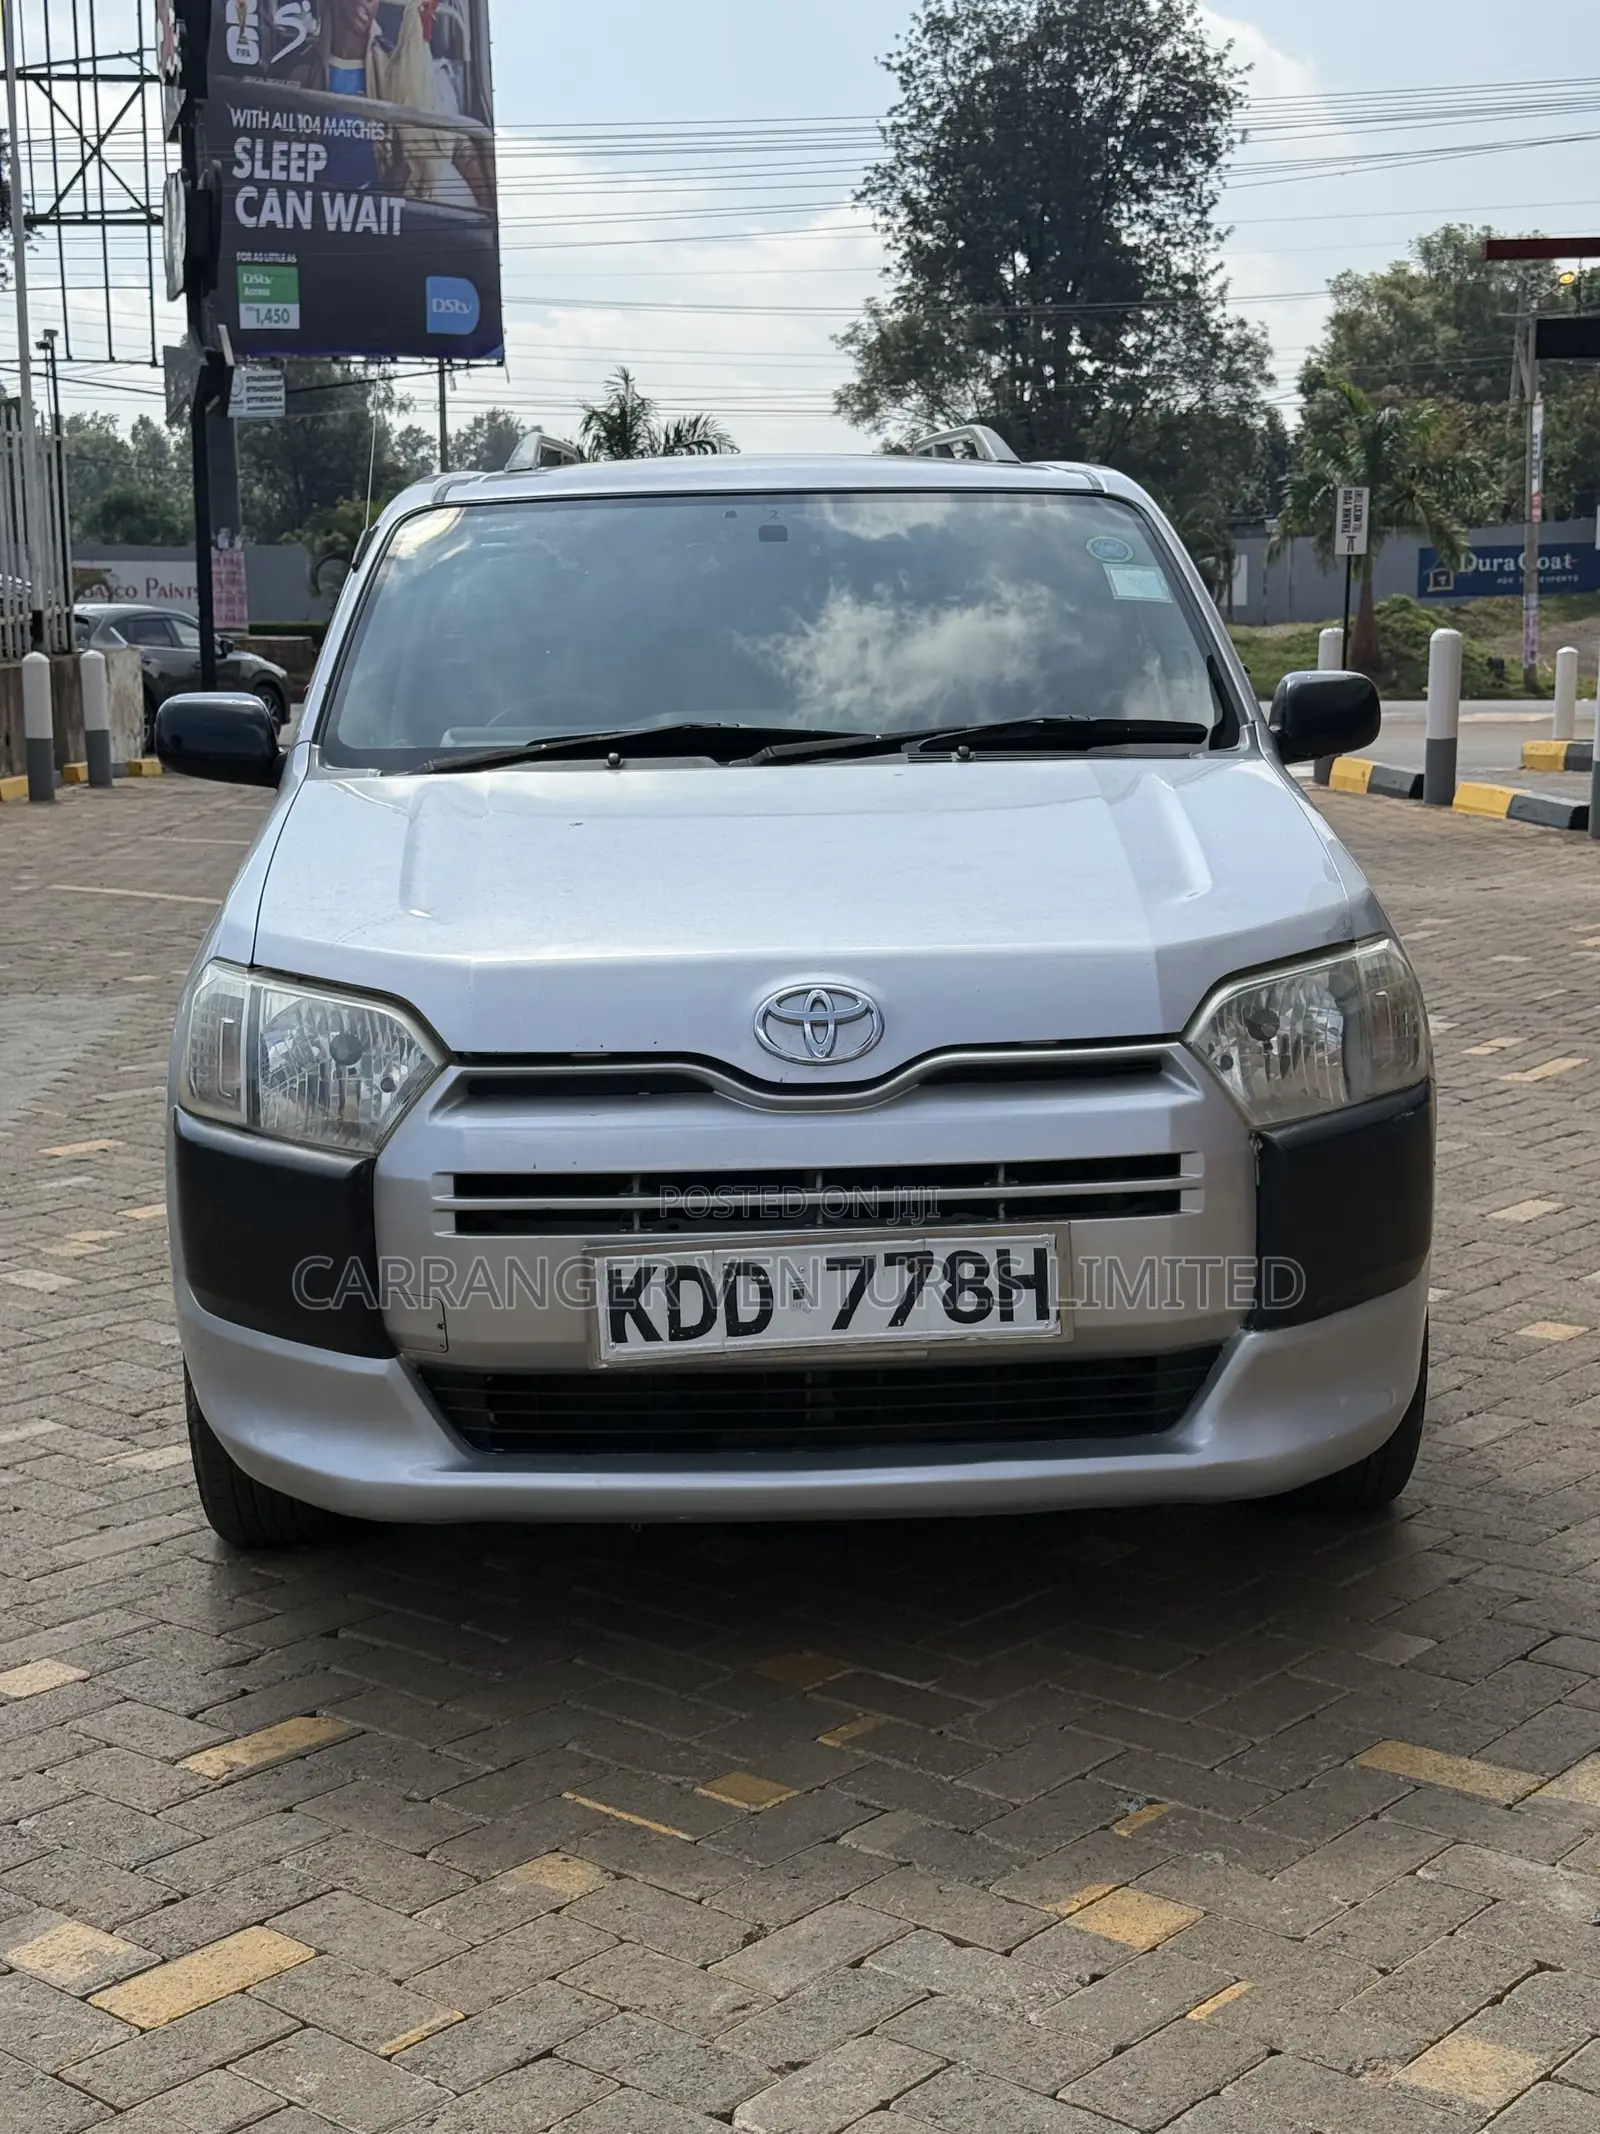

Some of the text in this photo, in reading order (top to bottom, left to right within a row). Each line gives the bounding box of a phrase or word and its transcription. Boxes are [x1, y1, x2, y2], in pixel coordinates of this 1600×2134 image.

[230, 107, 269, 129] WITH
[272, 112, 296, 133] ALL
[298, 114, 322, 135] 104
[232, 136, 328, 183] SLEEP
[235, 185, 406, 236] CAN WAIT
[236, 252, 252, 261] FOR
[253, 252, 263, 262] AS
[287, 254, 297, 263] AS
[254, 307, 290, 326] 1,450
[432, 298, 472, 314] DStv
[1341, 490, 1353, 533] THANK YOU
[1354, 504, 1363, 522] NEXT
[605, 1247, 1051, 1344] KDD 778H
